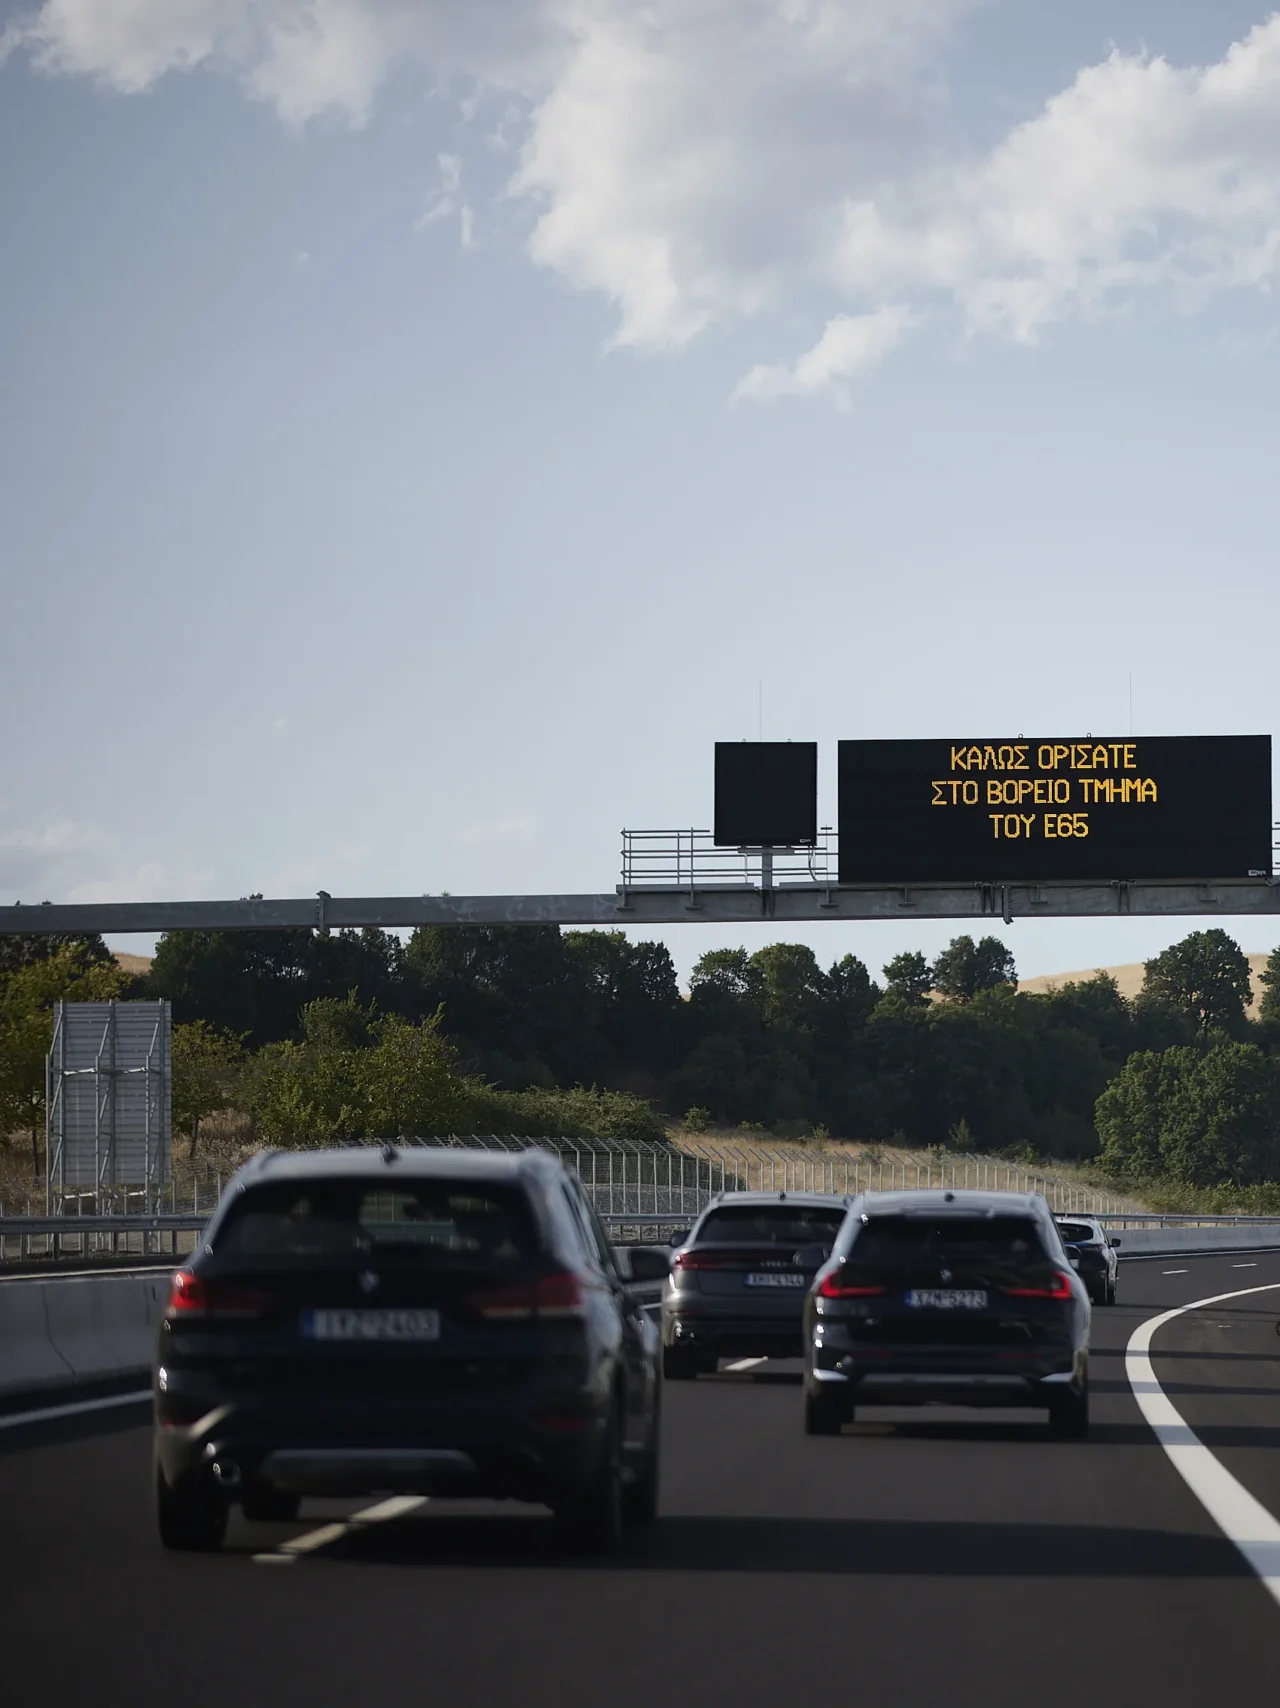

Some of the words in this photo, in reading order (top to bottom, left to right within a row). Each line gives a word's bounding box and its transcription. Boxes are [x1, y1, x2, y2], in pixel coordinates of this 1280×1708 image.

[950, 744, 1030, 771] ΚΑΛΩΣ
[1037, 743, 1137, 770] ΟΡΙΣΑΤΕ
[931, 780, 979, 806] ΣΤΟ
[986, 779, 1070, 804] ΒΟΡΕΙΟ
[1078, 777, 1158, 803] ΤΜΗΜΑ
[989, 814, 1036, 839] ΤΟΥ
[1044, 813, 1089, 838] Ε65
